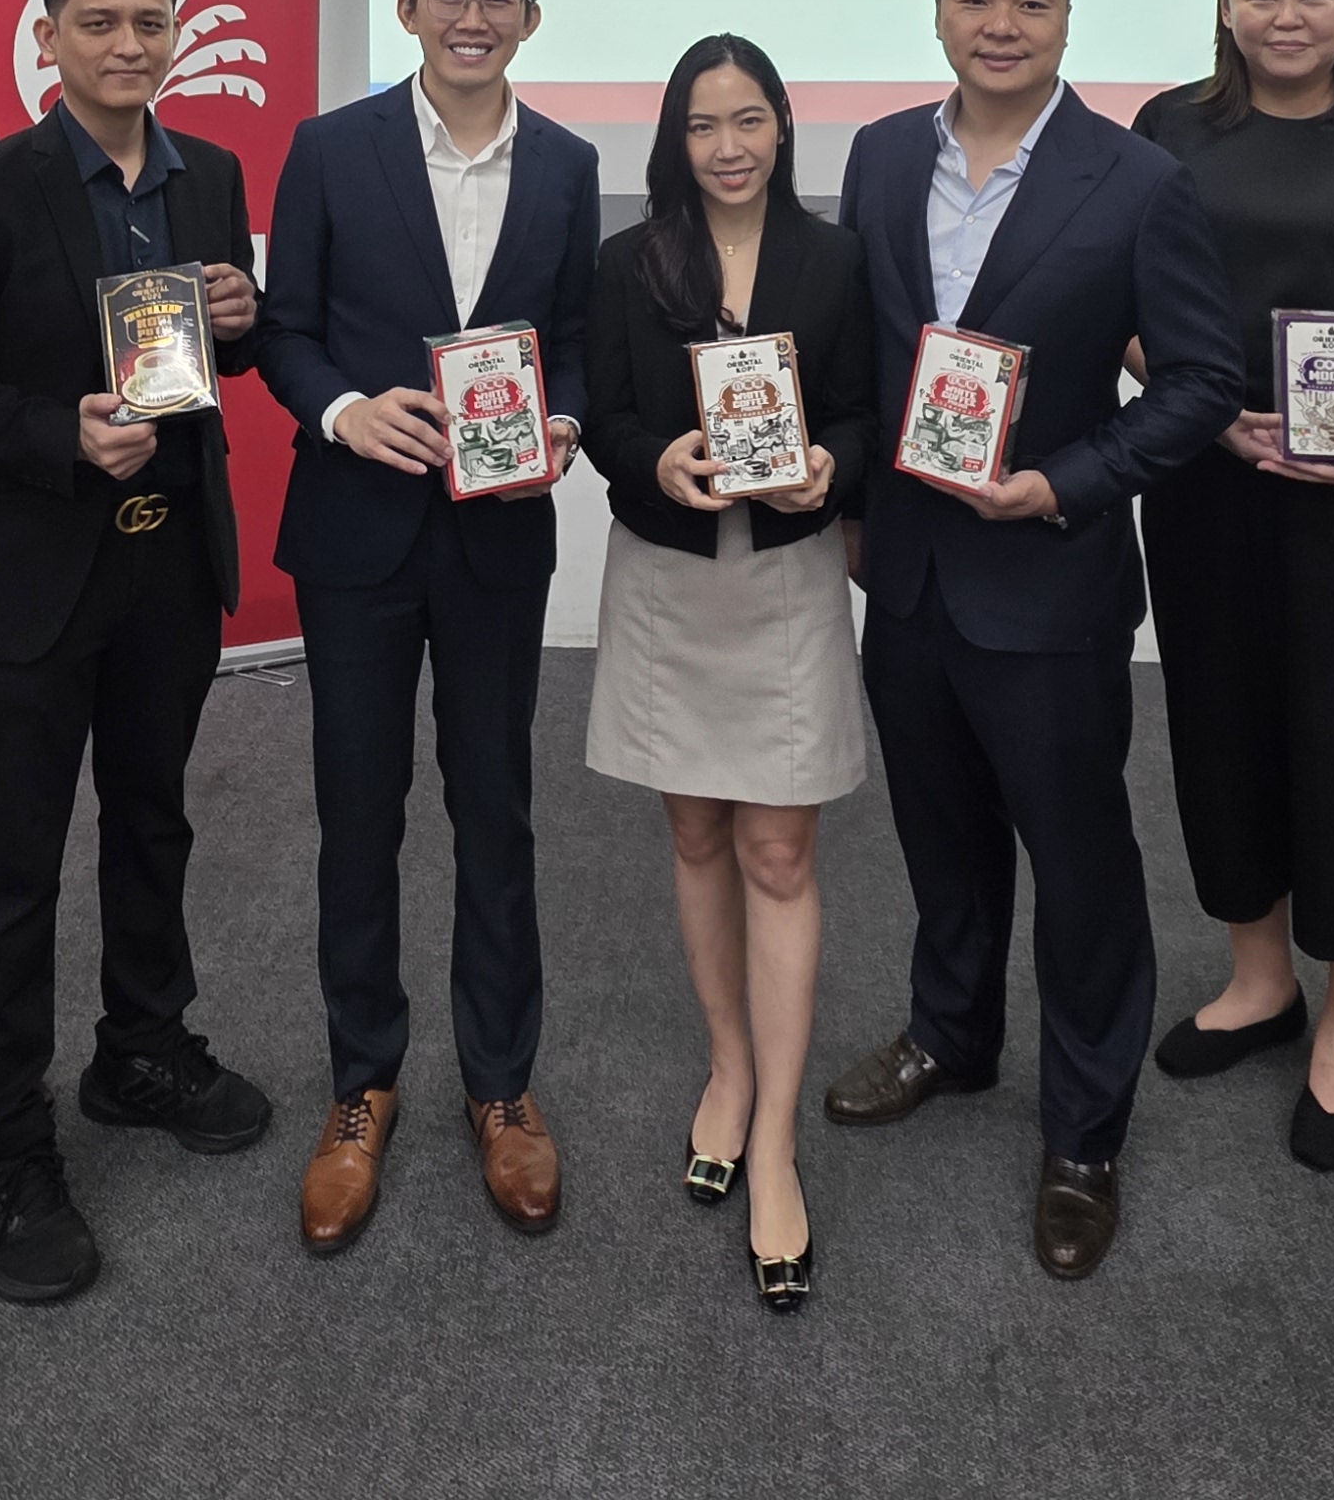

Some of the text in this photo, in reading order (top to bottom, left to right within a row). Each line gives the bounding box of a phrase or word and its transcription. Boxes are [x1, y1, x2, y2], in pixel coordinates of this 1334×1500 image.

[468, 357, 506, 369] ORIENTAL
[726, 358, 763, 368] ORIENTAL
[477, 364, 499, 373] KOPI
[735, 365, 756, 373] KOPI
